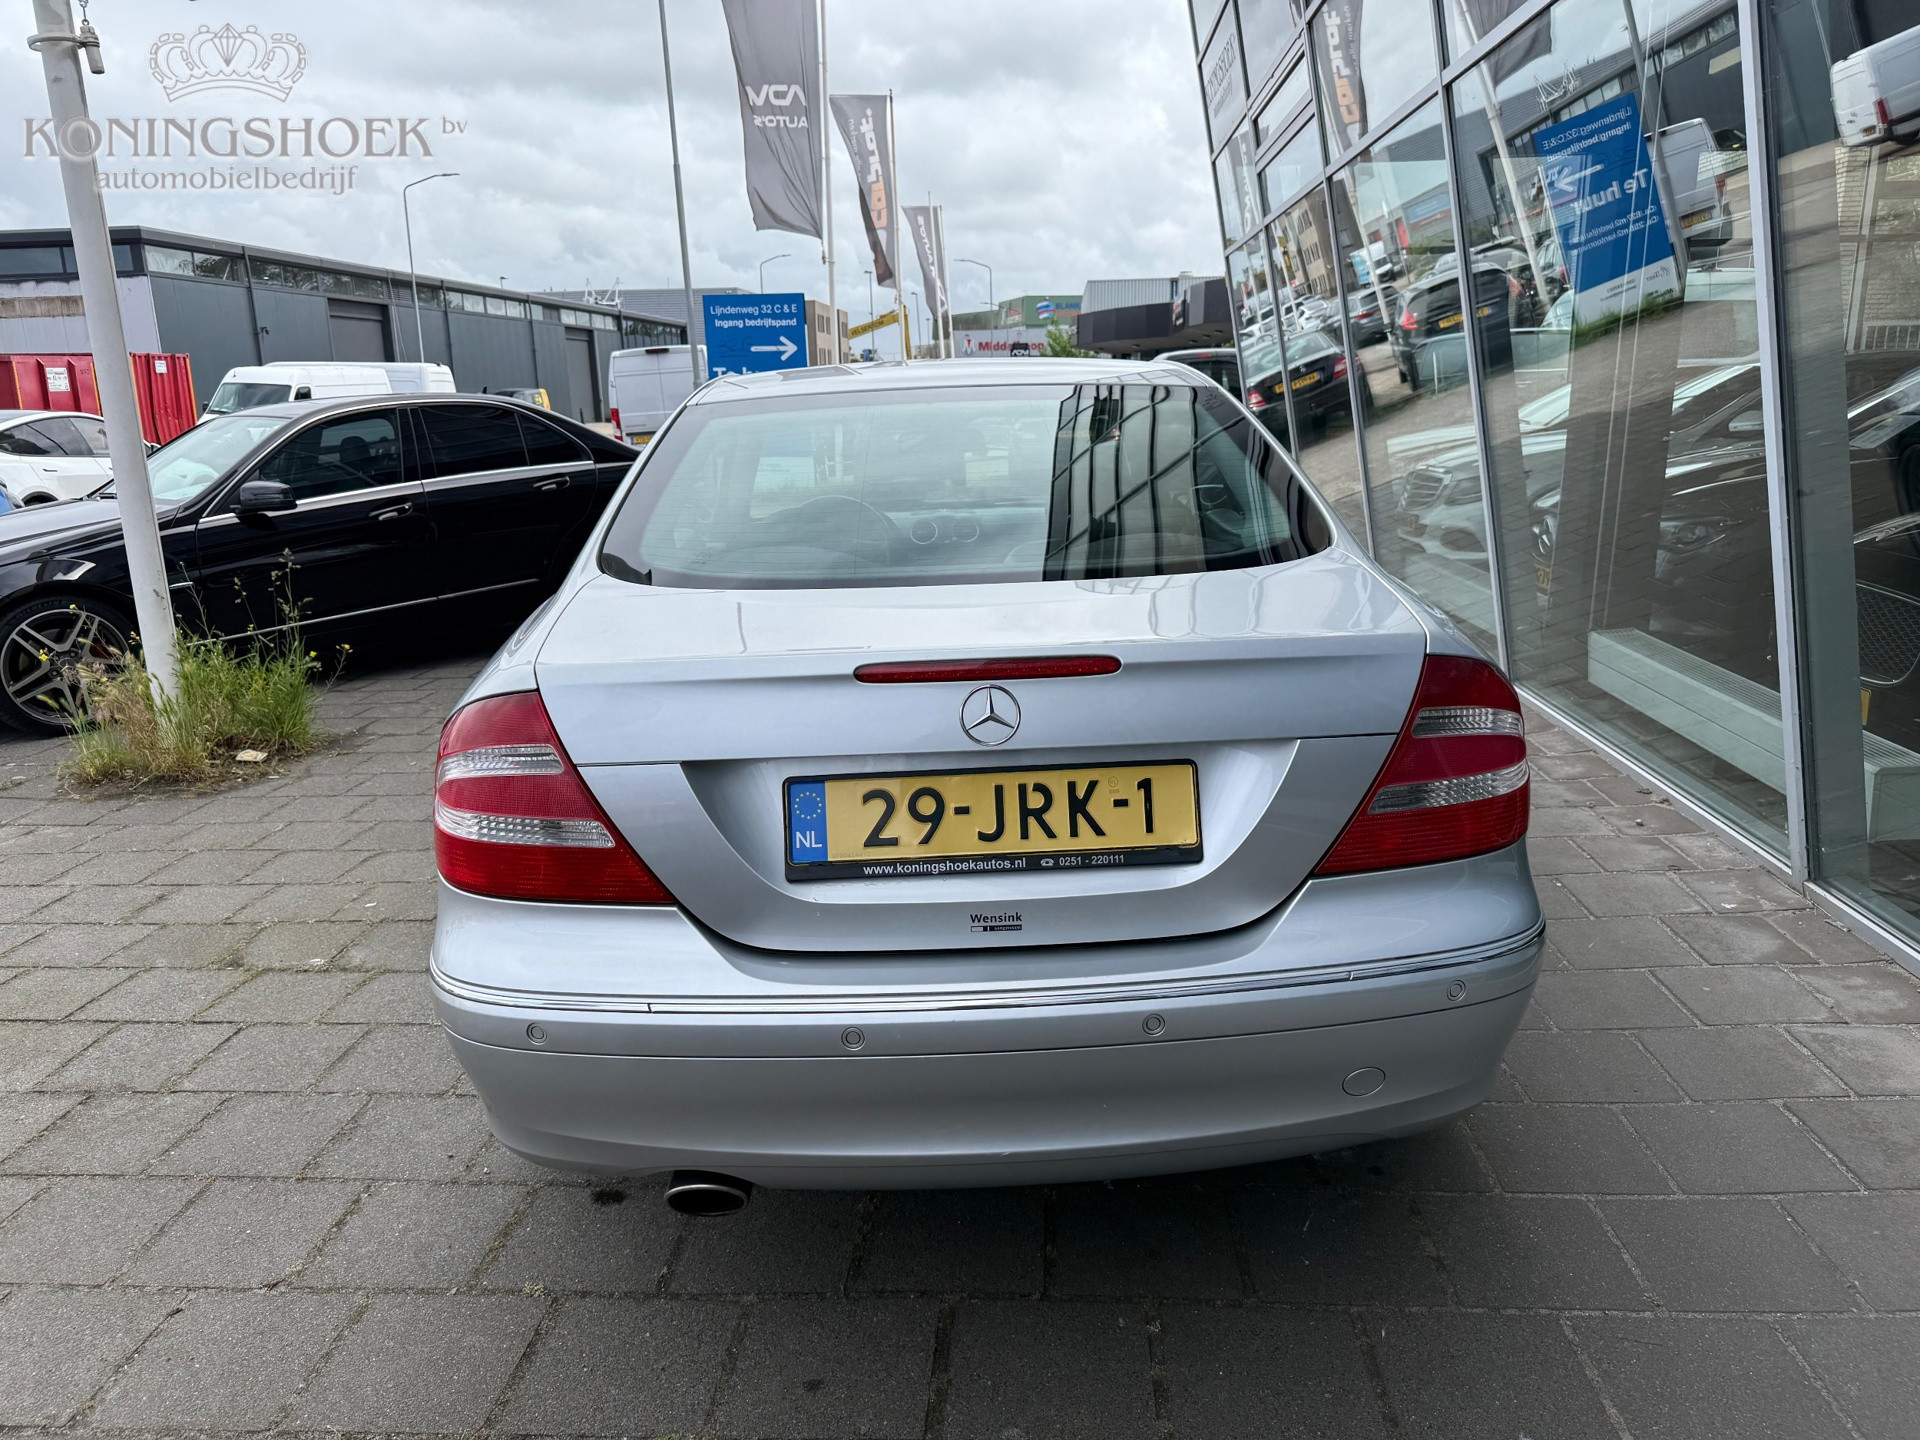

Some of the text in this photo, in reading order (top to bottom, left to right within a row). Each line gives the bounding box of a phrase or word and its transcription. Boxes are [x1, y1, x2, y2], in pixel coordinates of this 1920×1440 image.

[710, 304, 797, 316] Lijndenweg 32 C & E
[715, 318, 797, 328] Ingang bedrijfspand
[861, 777, 1155, 848] 29-JRK-1
[795, 831, 822, 849] NL
[863, 857, 1026, 875] www.koningshoekautos.nl
[1059, 856, 1082, 866] 0251
[1091, 855, 1124, 865] 220111
[970, 912, 1022, 923] Wensink
